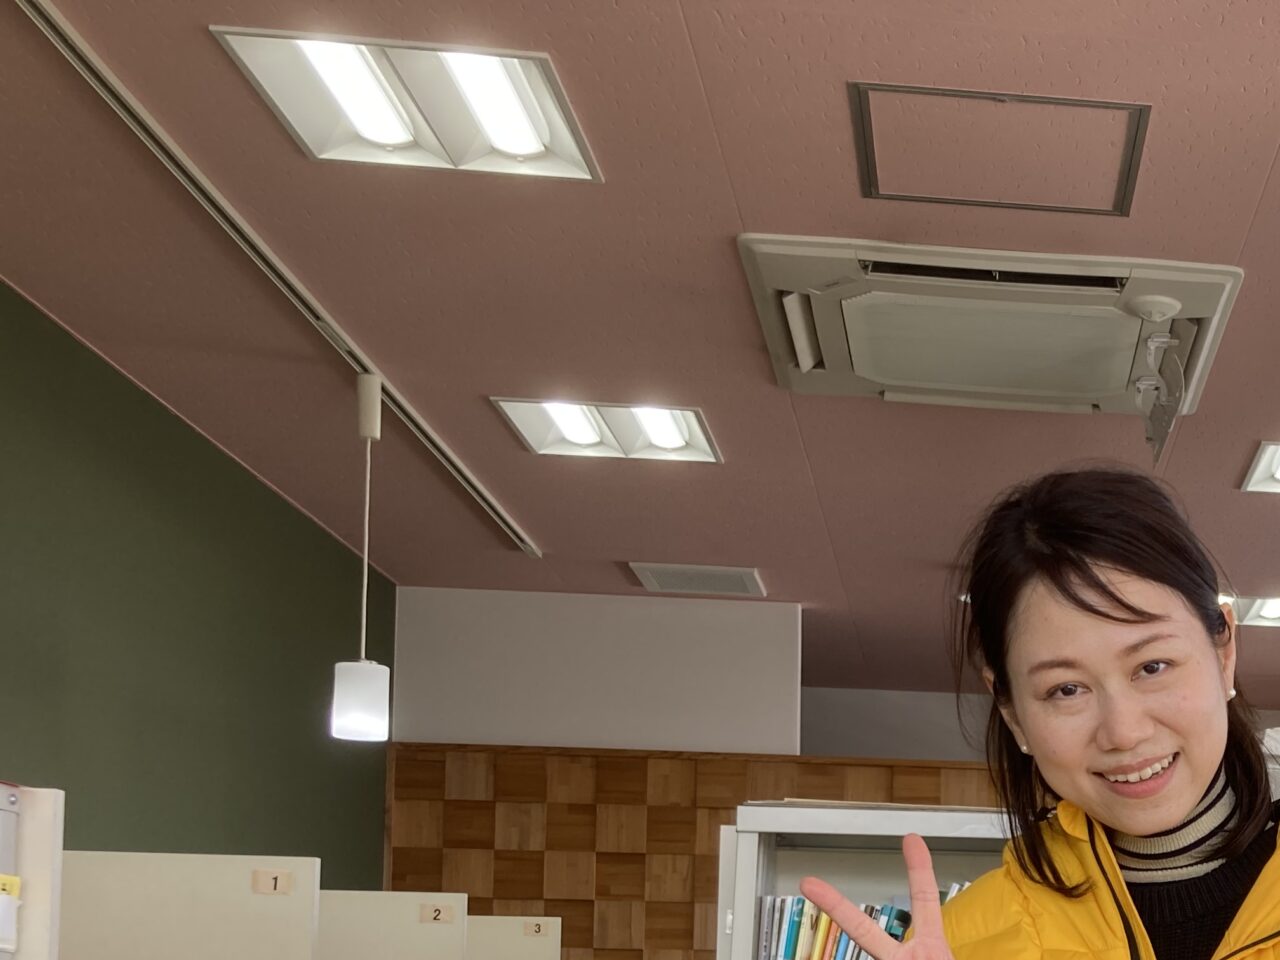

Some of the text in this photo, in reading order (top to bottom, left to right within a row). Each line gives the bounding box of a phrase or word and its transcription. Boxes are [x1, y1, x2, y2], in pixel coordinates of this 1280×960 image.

[271, 875, 279, 892] 1
[432, 908, 442, 922] 2
[533, 923, 542, 934] 3
